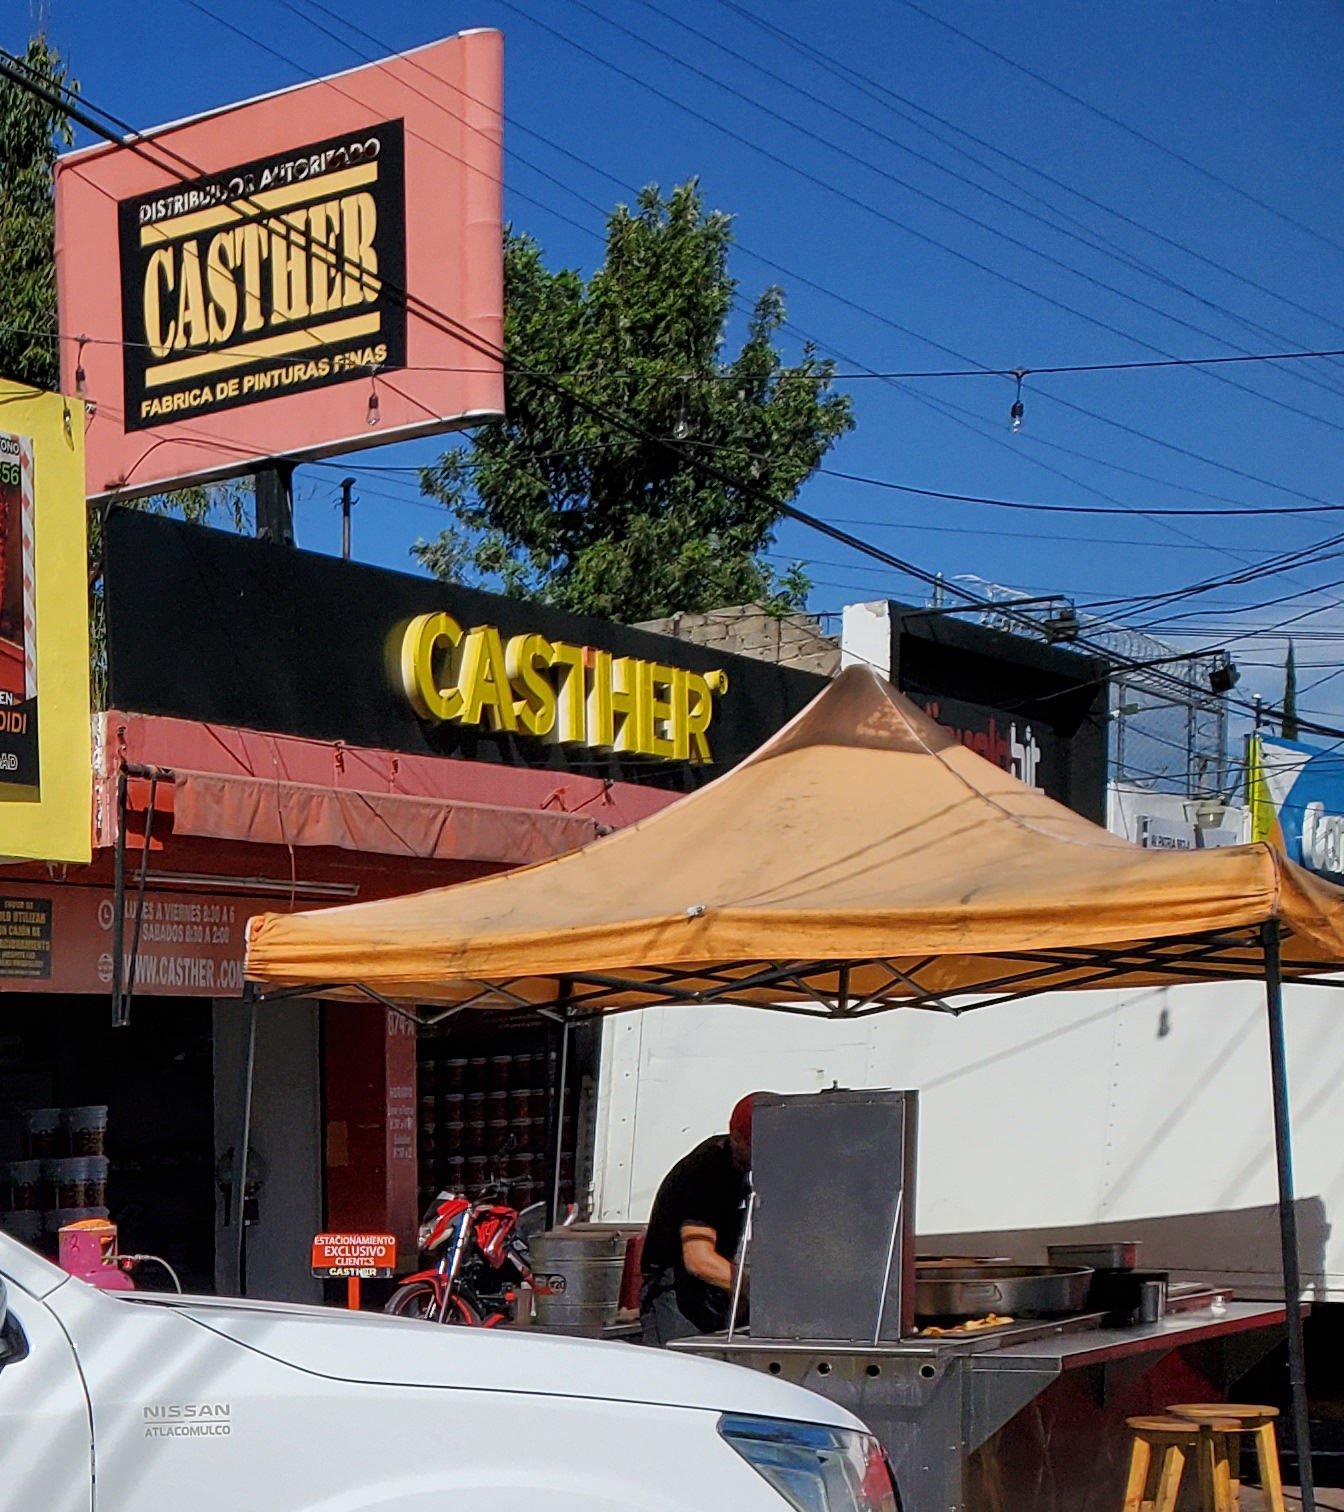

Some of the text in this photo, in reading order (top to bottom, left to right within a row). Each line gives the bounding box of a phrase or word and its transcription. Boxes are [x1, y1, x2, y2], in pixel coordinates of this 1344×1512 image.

[258, 137, 381, 190] AUTORIZADO
[143, 191, 382, 358] CASTHER
[141, 344, 388, 419] FABRICA DE PINTURAS FINAS
[402, 612, 712, 763] CASTHER
[124, 900, 154, 920] LUES
[164, 903, 201, 922] VIERNES
[143, 923, 184, 943] SABADOS
[314, 1235, 396, 1245] ESTACIONAMIENTO
[324, 1246, 387, 1257] EXCLUSIVO
[335, 1257, 375, 1266] CLIENTES
[329, 1267, 376, 1276] CASTHER
[143, 1404, 231, 1418] NISSAN
[144, 1425, 231, 1438] ATLACOMULCO
